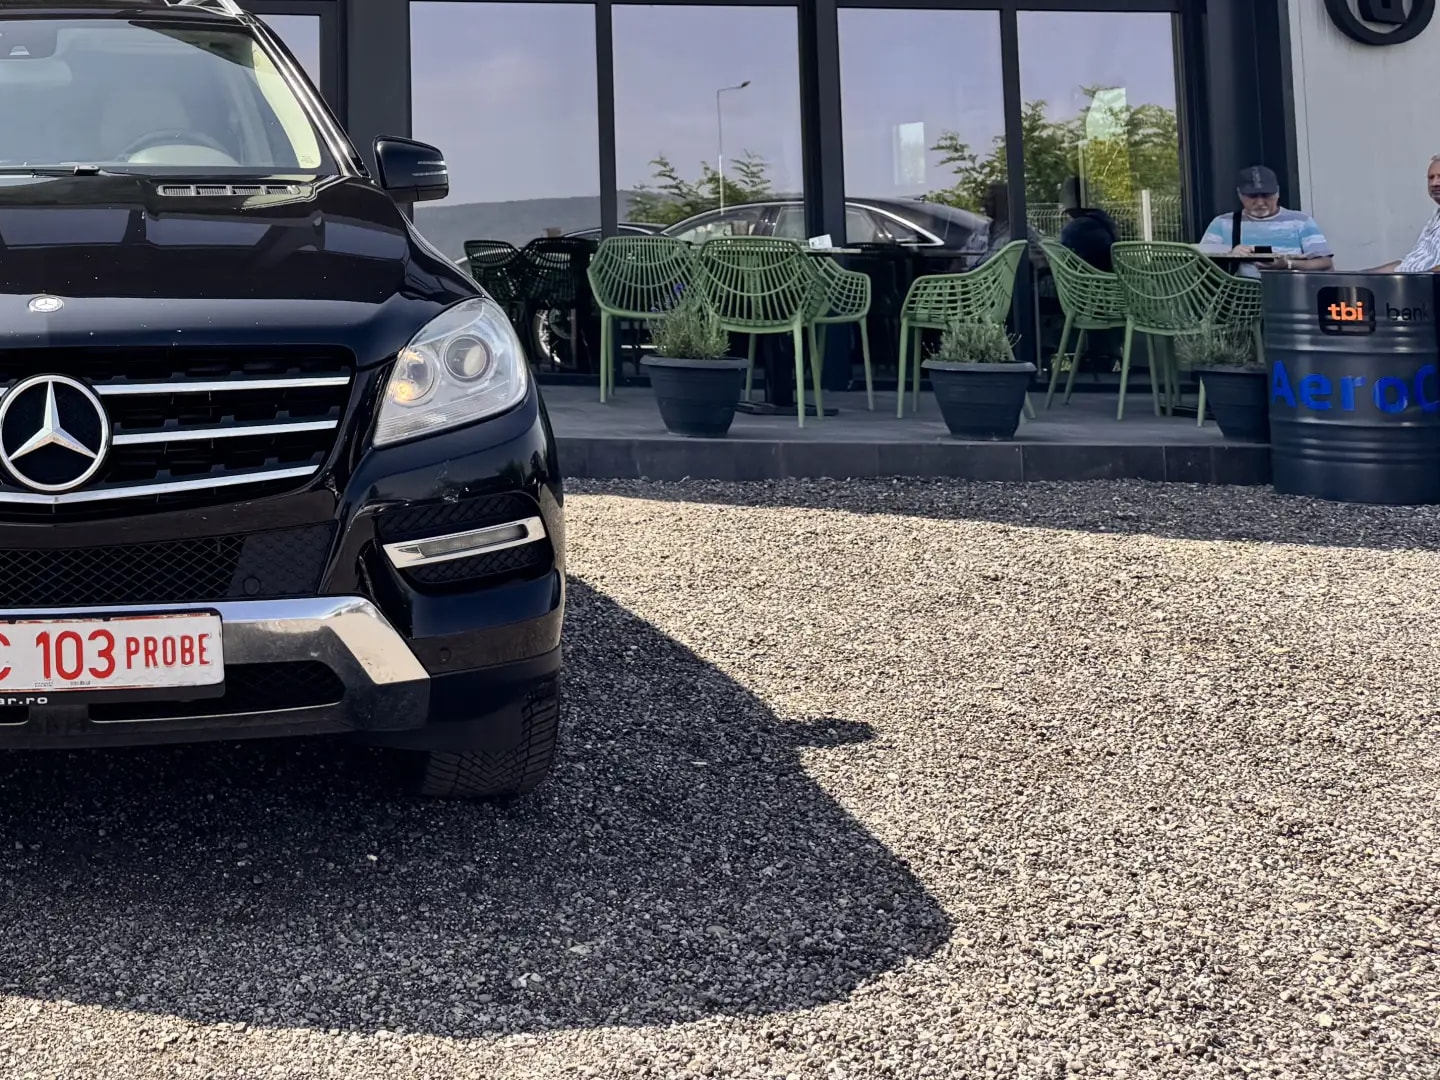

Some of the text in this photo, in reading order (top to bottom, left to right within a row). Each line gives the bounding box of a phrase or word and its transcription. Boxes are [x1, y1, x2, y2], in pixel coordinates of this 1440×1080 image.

[1328, 301, 1429, 321] tbi bank
[35, 629, 116, 681] 103
[126, 632, 213, 670] PROBE
